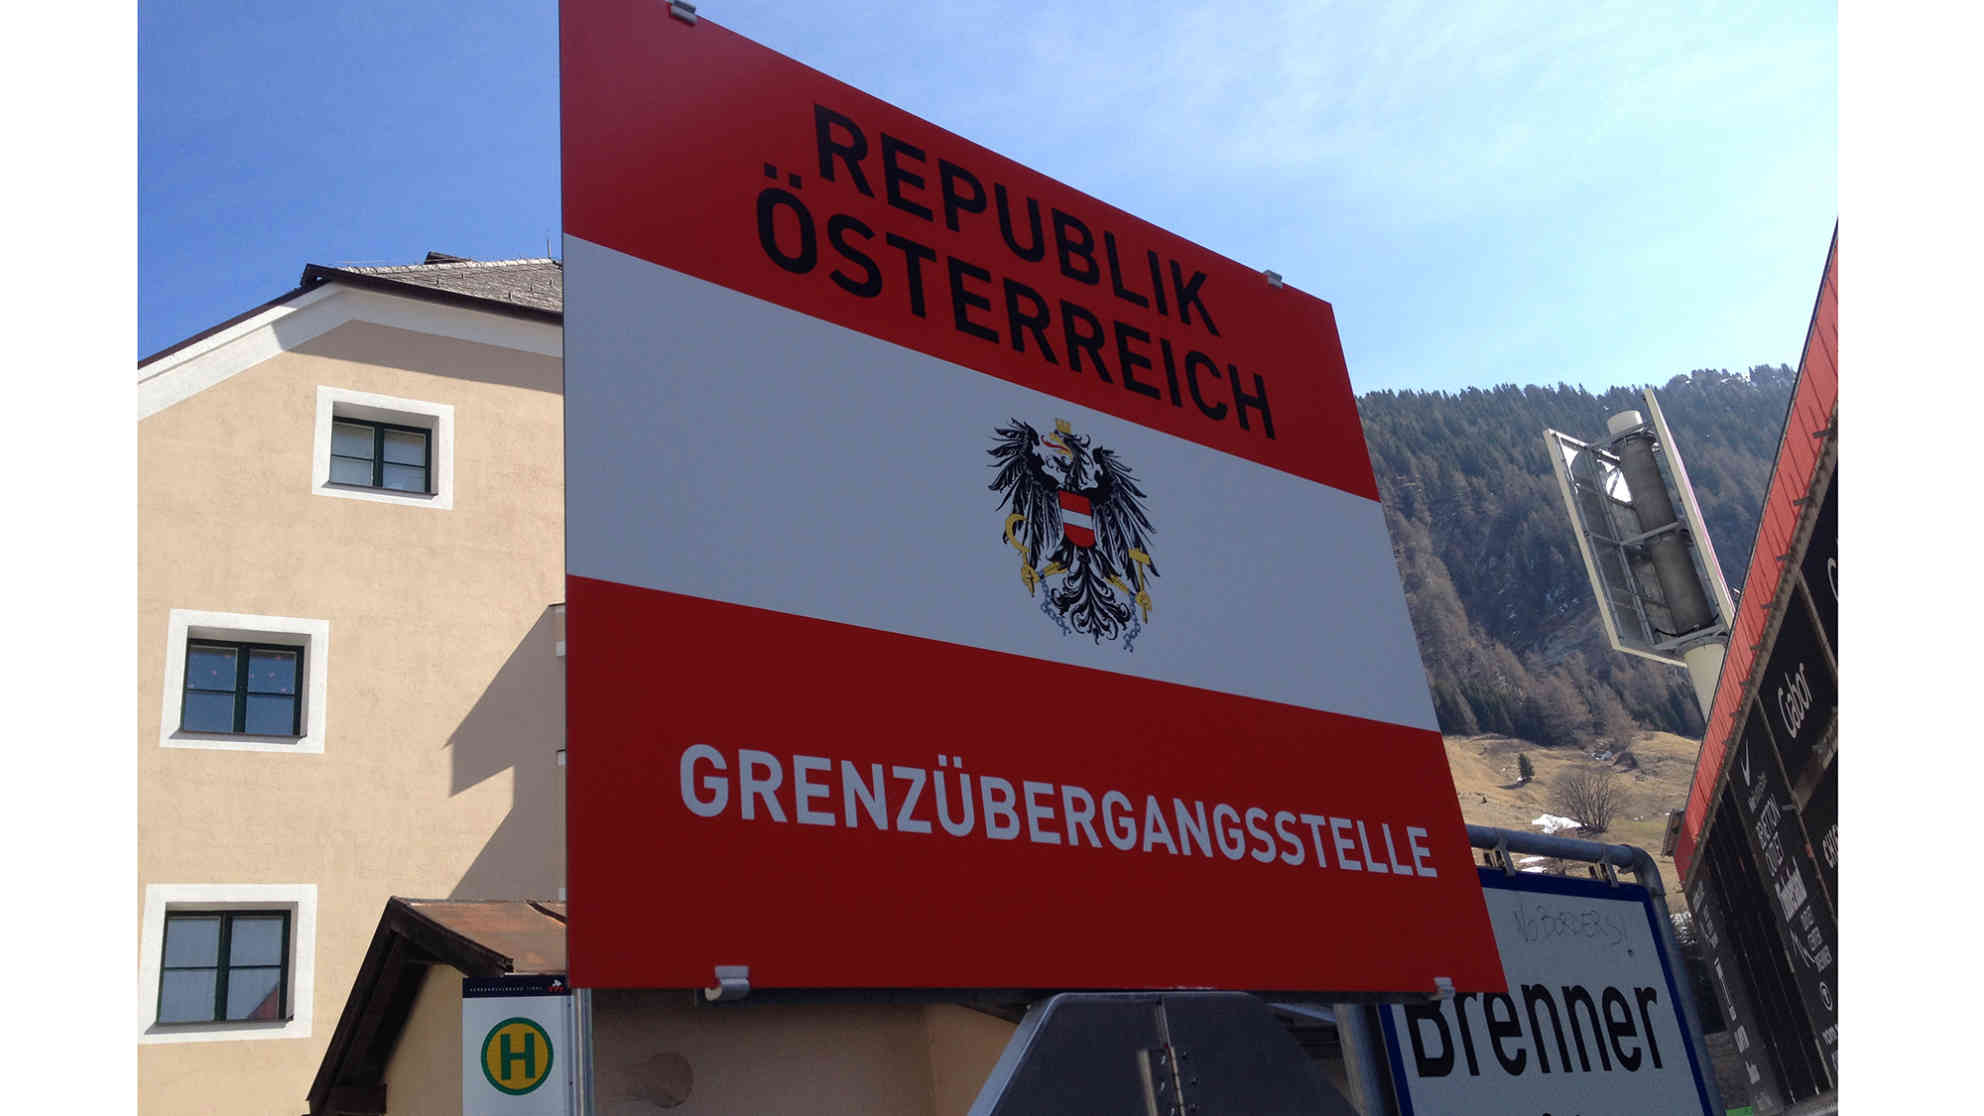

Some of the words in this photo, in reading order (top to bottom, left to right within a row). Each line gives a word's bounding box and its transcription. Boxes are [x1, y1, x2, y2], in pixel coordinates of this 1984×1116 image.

[814, 103, 1221, 337] REPUBLIK
[756, 162, 1275, 440] ÖSTERREICH
[1778, 662, 1813, 738] Gabor
[680, 744, 1438, 878] GRENZÜBERGANGSSTELLE
[501, 1033, 535, 1080] H
[1404, 984, 1663, 1077] Brenner
